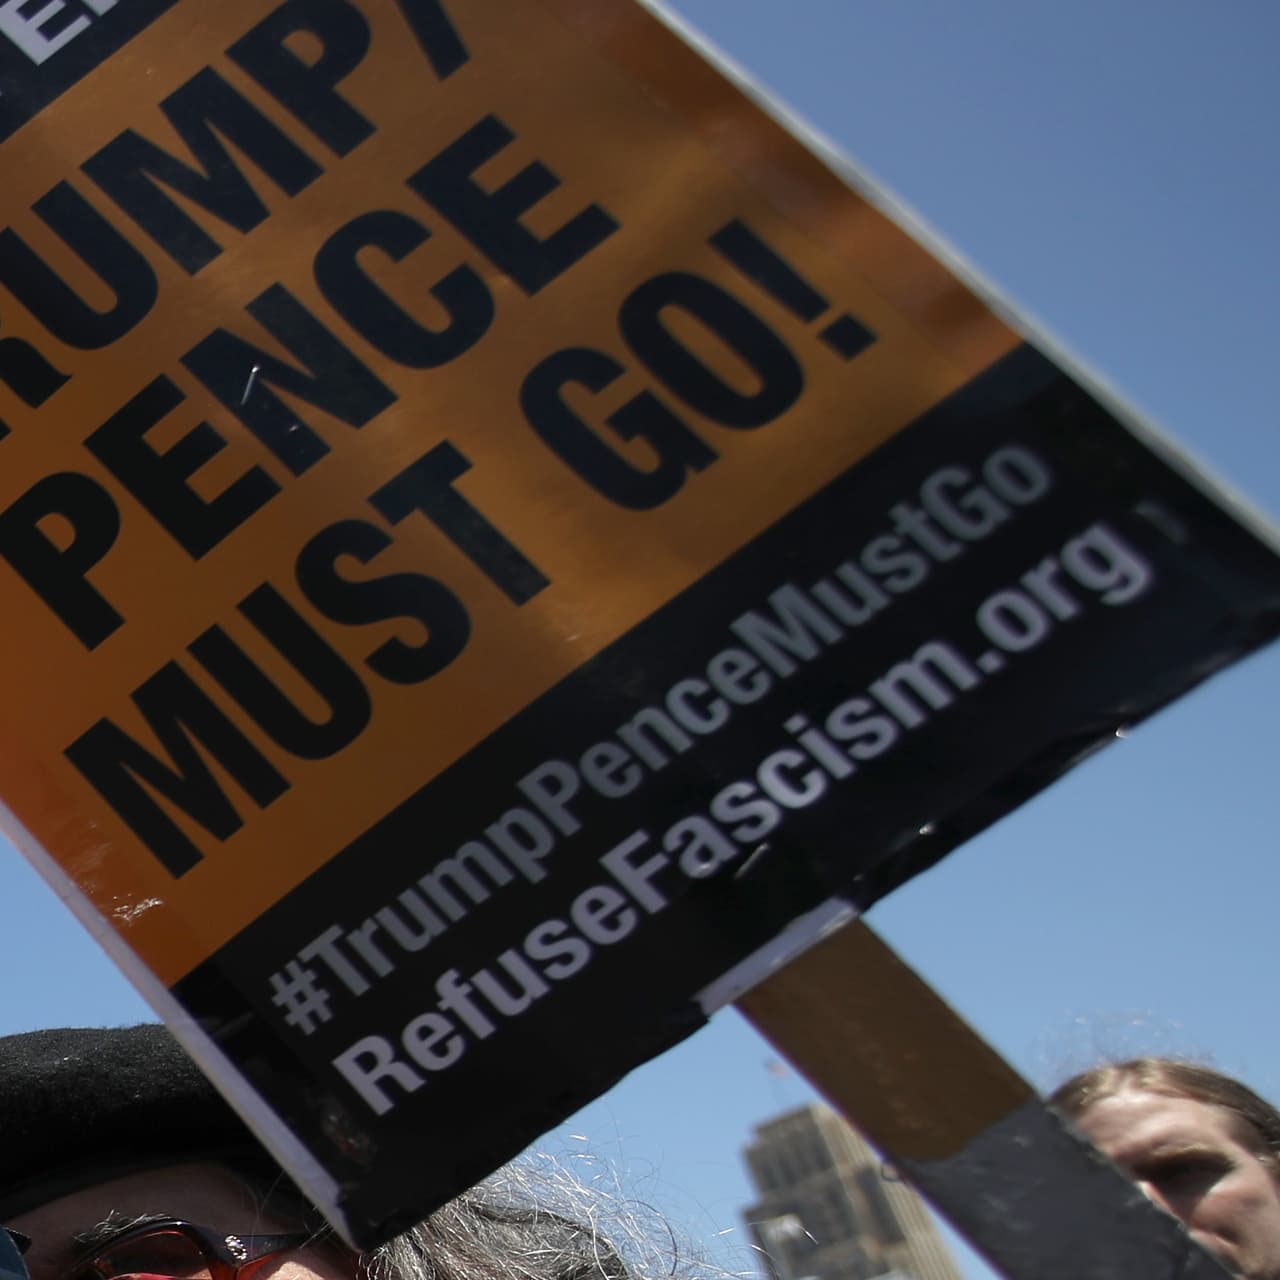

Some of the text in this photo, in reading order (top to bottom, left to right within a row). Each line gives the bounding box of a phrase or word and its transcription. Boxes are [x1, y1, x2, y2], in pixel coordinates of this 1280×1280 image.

[62, 218, 879, 881] MUST GO!
[267, 444, 1053, 1036] #TrumpPenceMustGo
[331, 522, 1156, 1116] RefuseFascism.org
